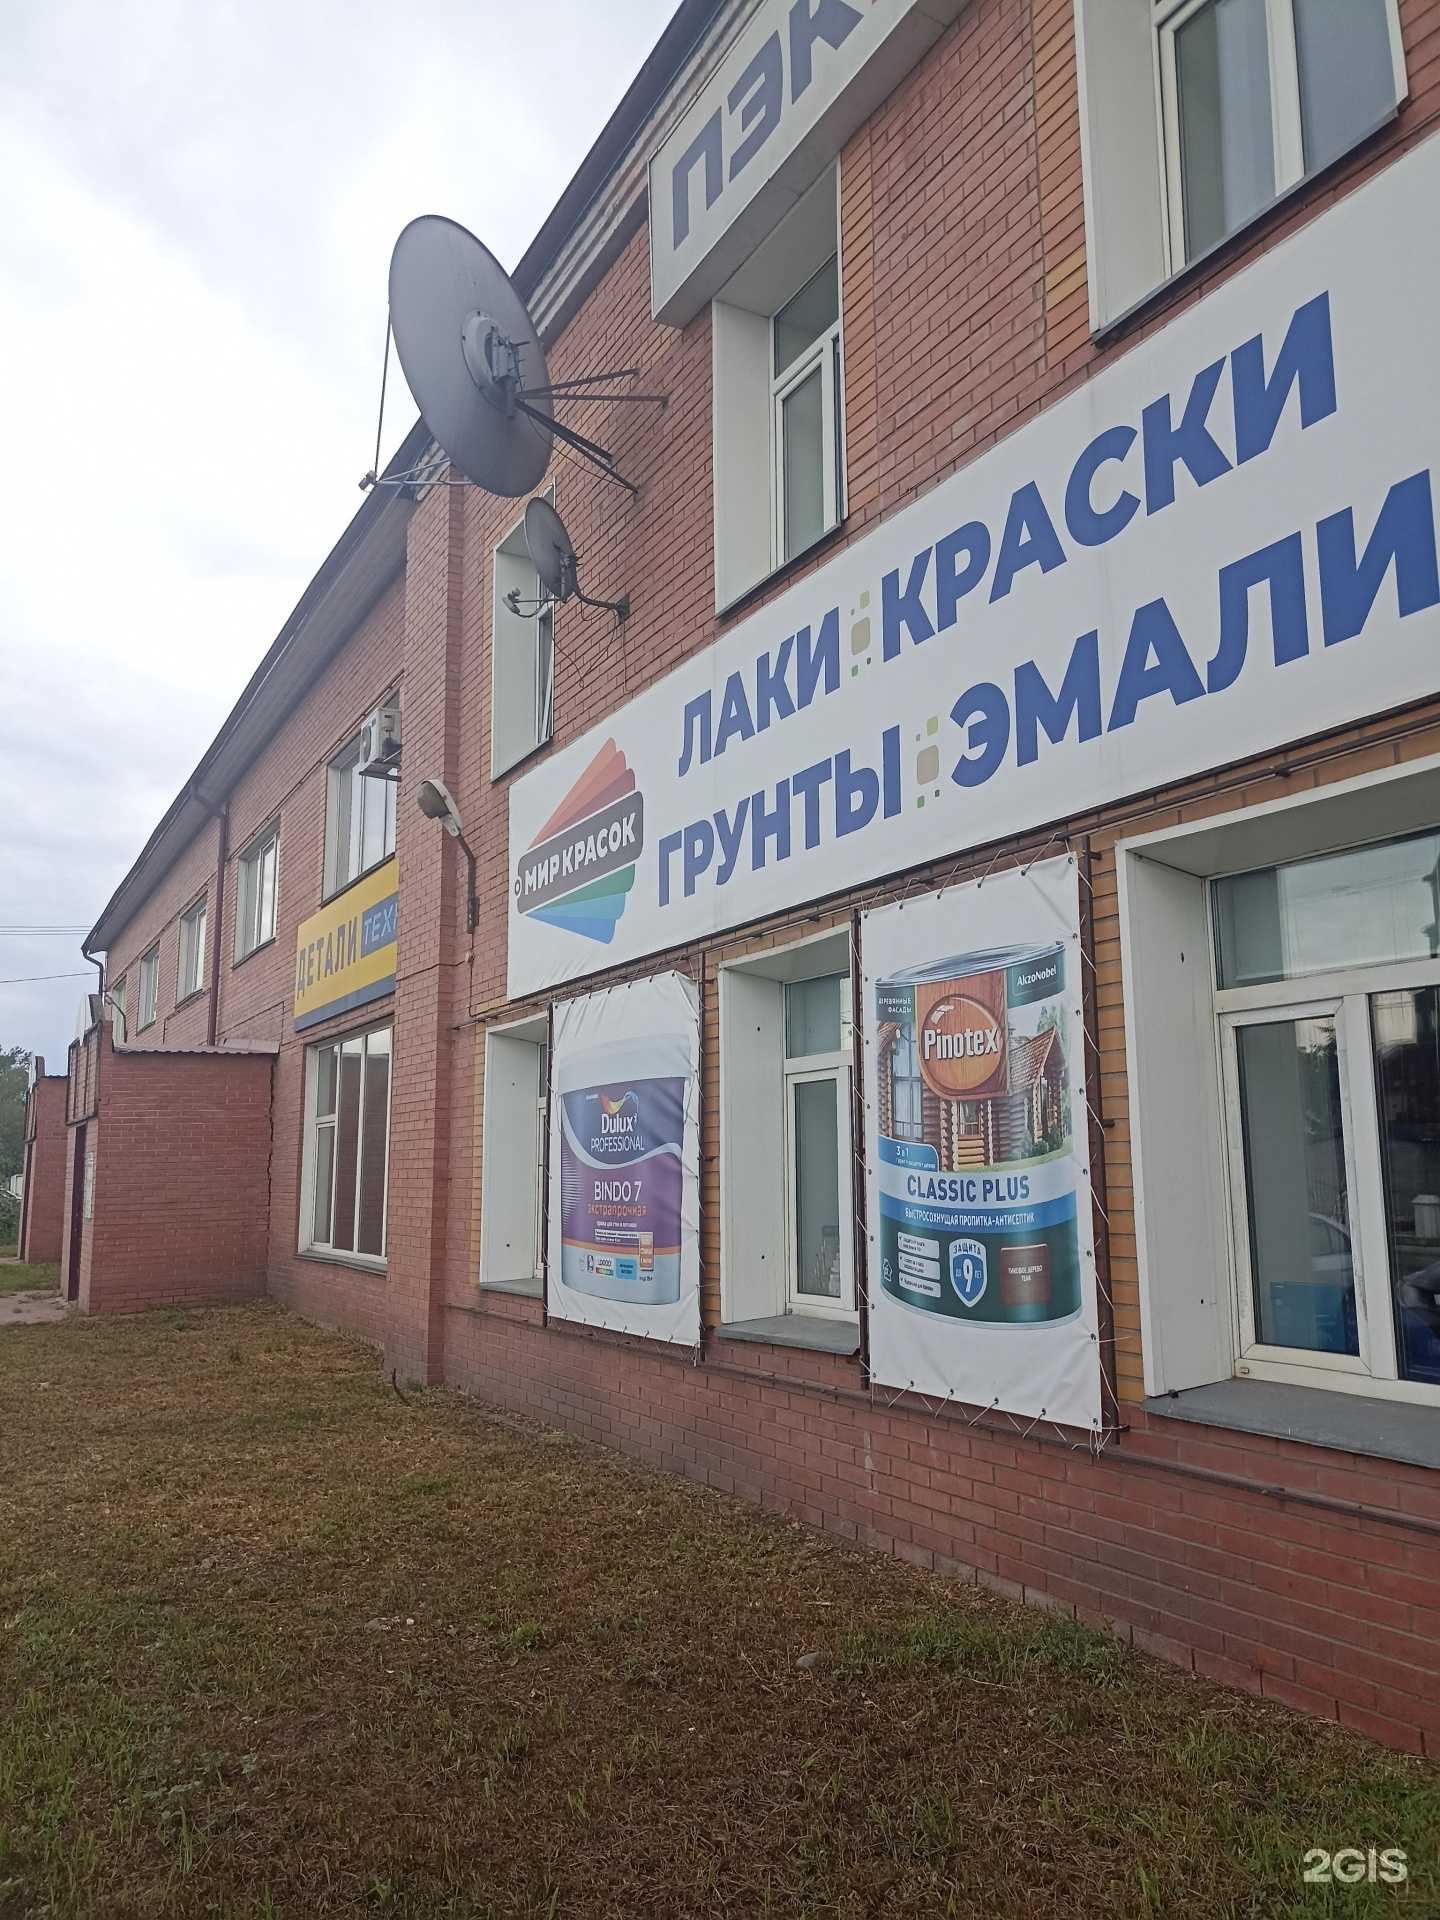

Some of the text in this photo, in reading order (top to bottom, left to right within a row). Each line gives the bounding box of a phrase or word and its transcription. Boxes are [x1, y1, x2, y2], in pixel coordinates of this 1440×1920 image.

[672, 0, 880, 250] ПЭК
[678, 289, 1337, 778] ЛАКИ КРАСКИ
[659, 468, 1440, 907] ГРУНТЫ ЭМАЛИ
[523, 812, 637, 896] МИР КРАСОК
[296, 916, 358, 1000] ДЕТАЛИ
[1016, 965, 1057, 988] AkzoNobel
[924, 1025, 999, 1060] Pinotex
[601, 1113, 633, 1134] Dulux
[590, 1136, 644, 1152] PROFESSIONAL
[896, 1145, 901, 1156] 3
[594, 1180, 642, 1202] BINDO 7
[907, 1174, 1030, 1201] CLASSIC PLUS
[953, 1242, 981, 1255] ЗАЩИТА
[963, 1258, 973, 1293] 9
